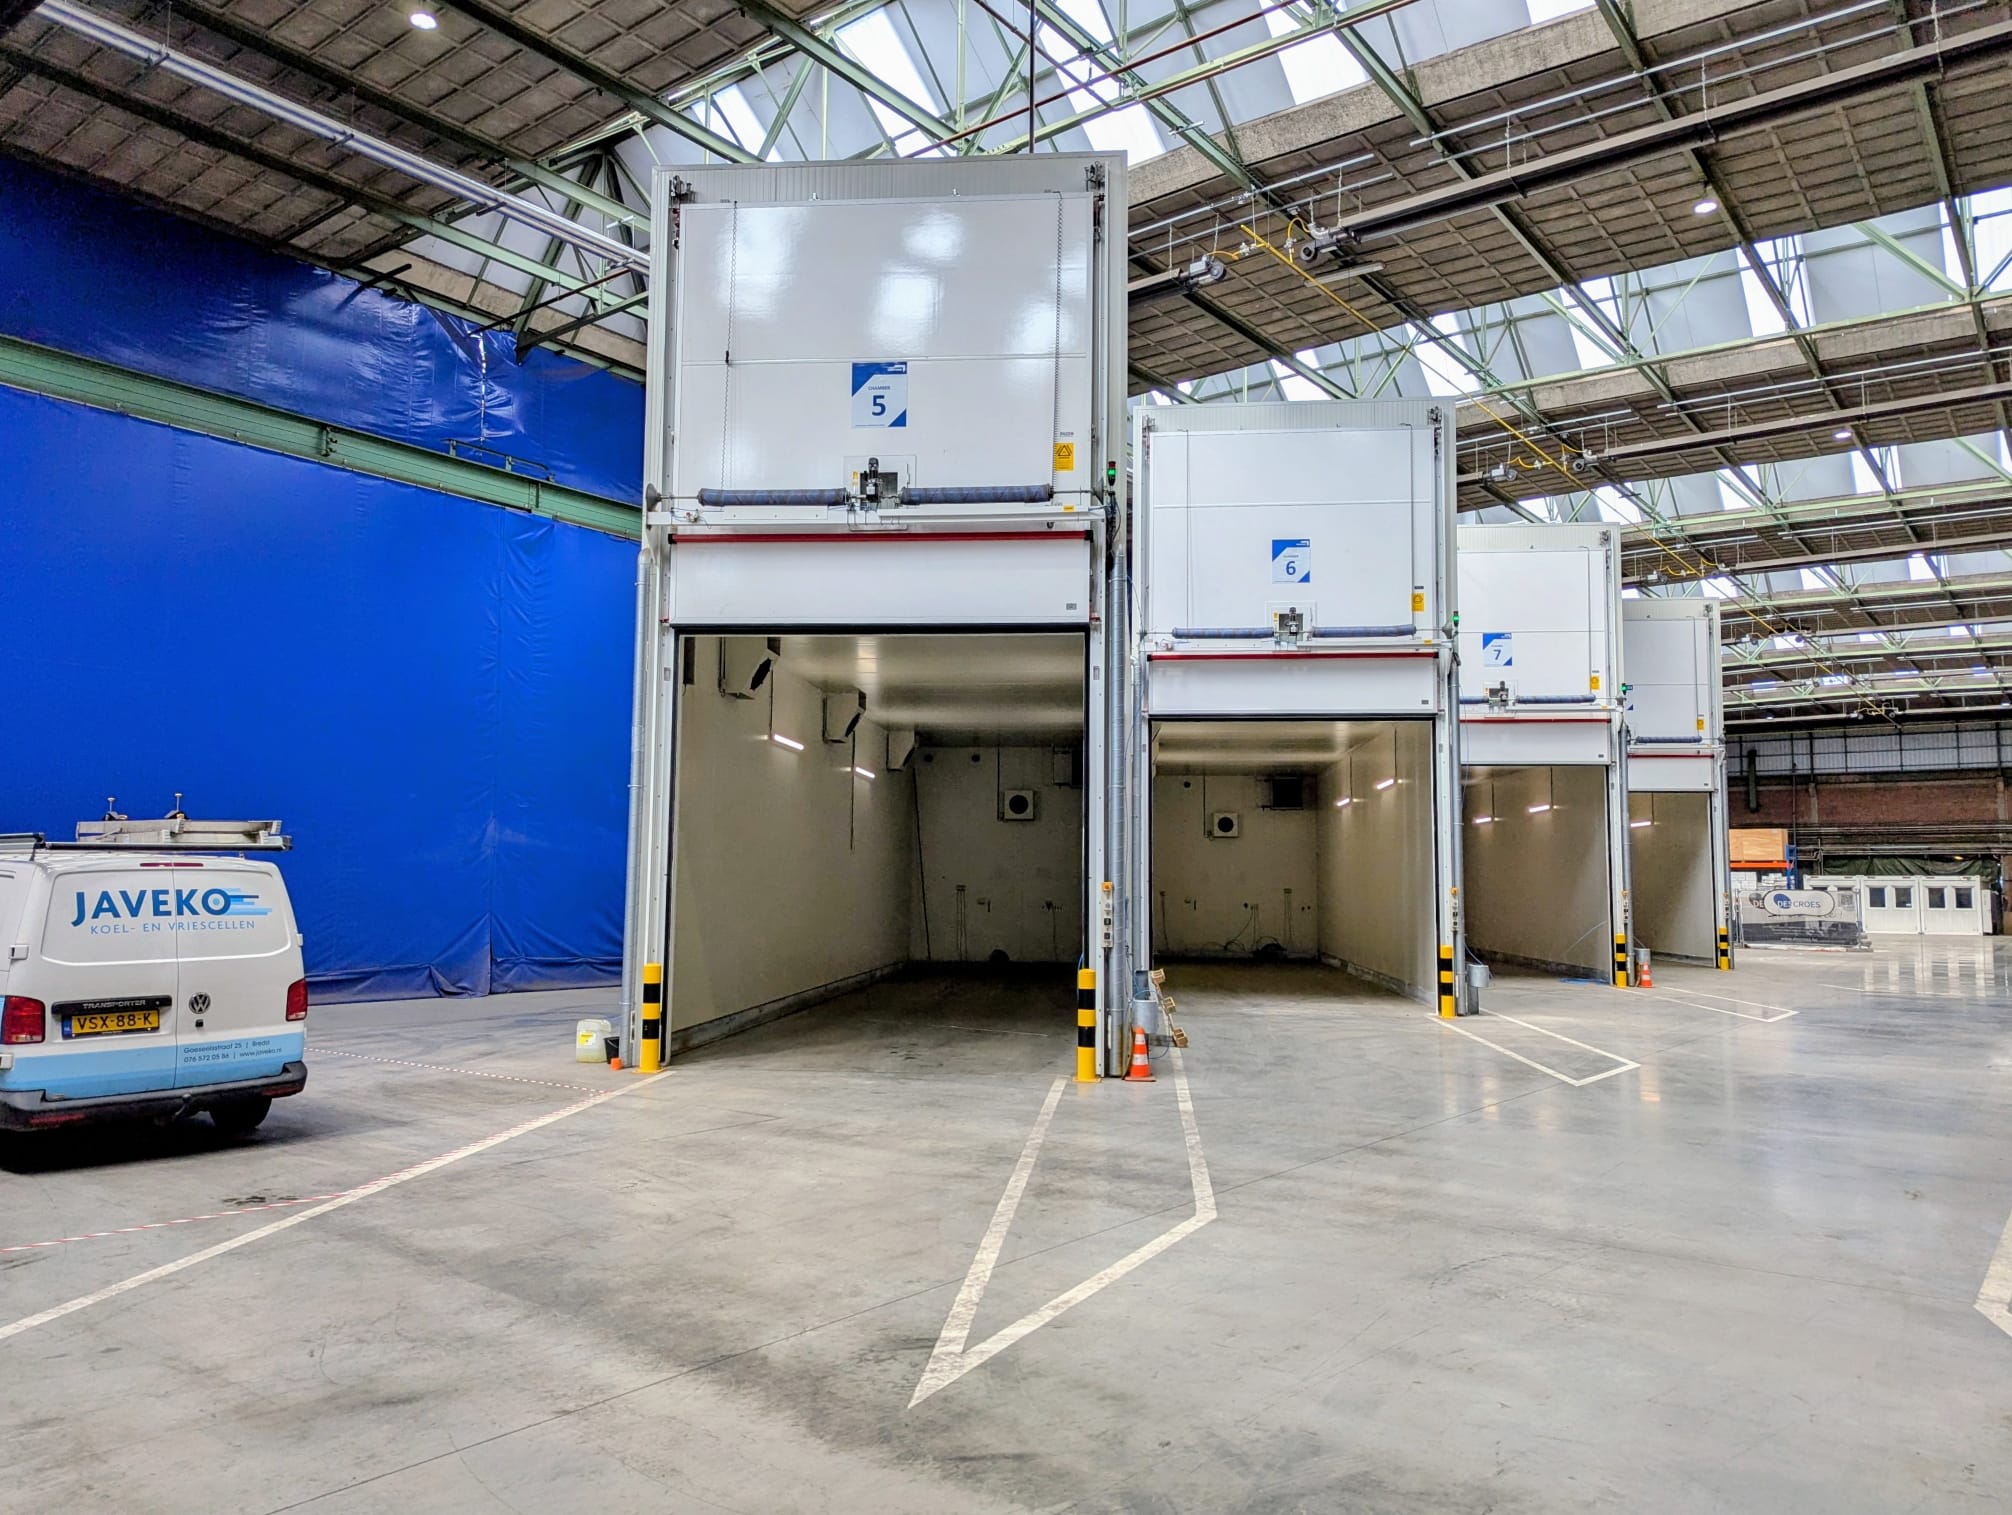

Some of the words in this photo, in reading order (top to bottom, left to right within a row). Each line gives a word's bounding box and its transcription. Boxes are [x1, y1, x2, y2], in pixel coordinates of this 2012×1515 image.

[872, 395, 886, 416] 5
[1286, 560, 1297, 576] 6
[1493, 649, 1502, 661] 7
[71, 888, 232, 927] JAVEKO
[90, 924, 136, 935] KOEL-
[143, 922, 161, 932] EN
[168, 920, 256, 931] VRIESCELLEN
[82, 1000, 146, 1009] TRANSPORTER
[76, 1012, 153, 1031] VSX-88-K
